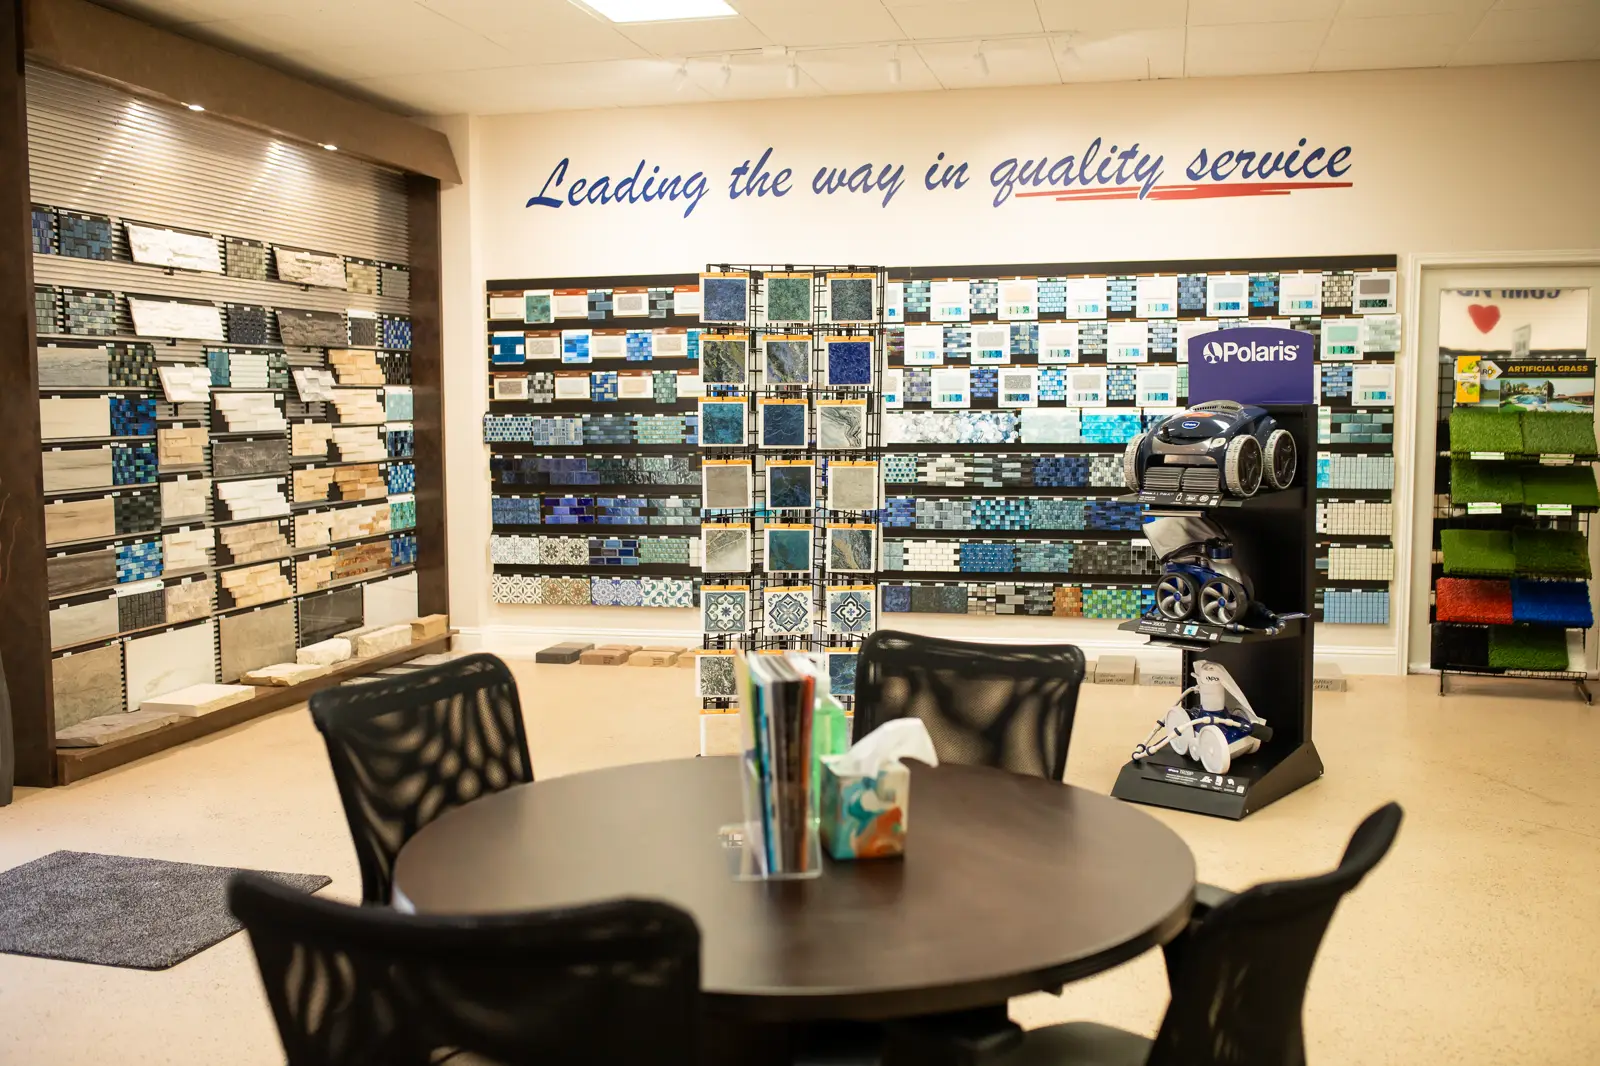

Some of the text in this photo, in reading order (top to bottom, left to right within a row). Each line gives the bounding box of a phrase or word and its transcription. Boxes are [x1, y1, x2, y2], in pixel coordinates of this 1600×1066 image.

[526, 137, 1352, 218] Leading the way in quality service
[1223, 340, 1299, 362] Polaris
[1507, 365, 1588, 373] ARTIFICIAL GRASS
